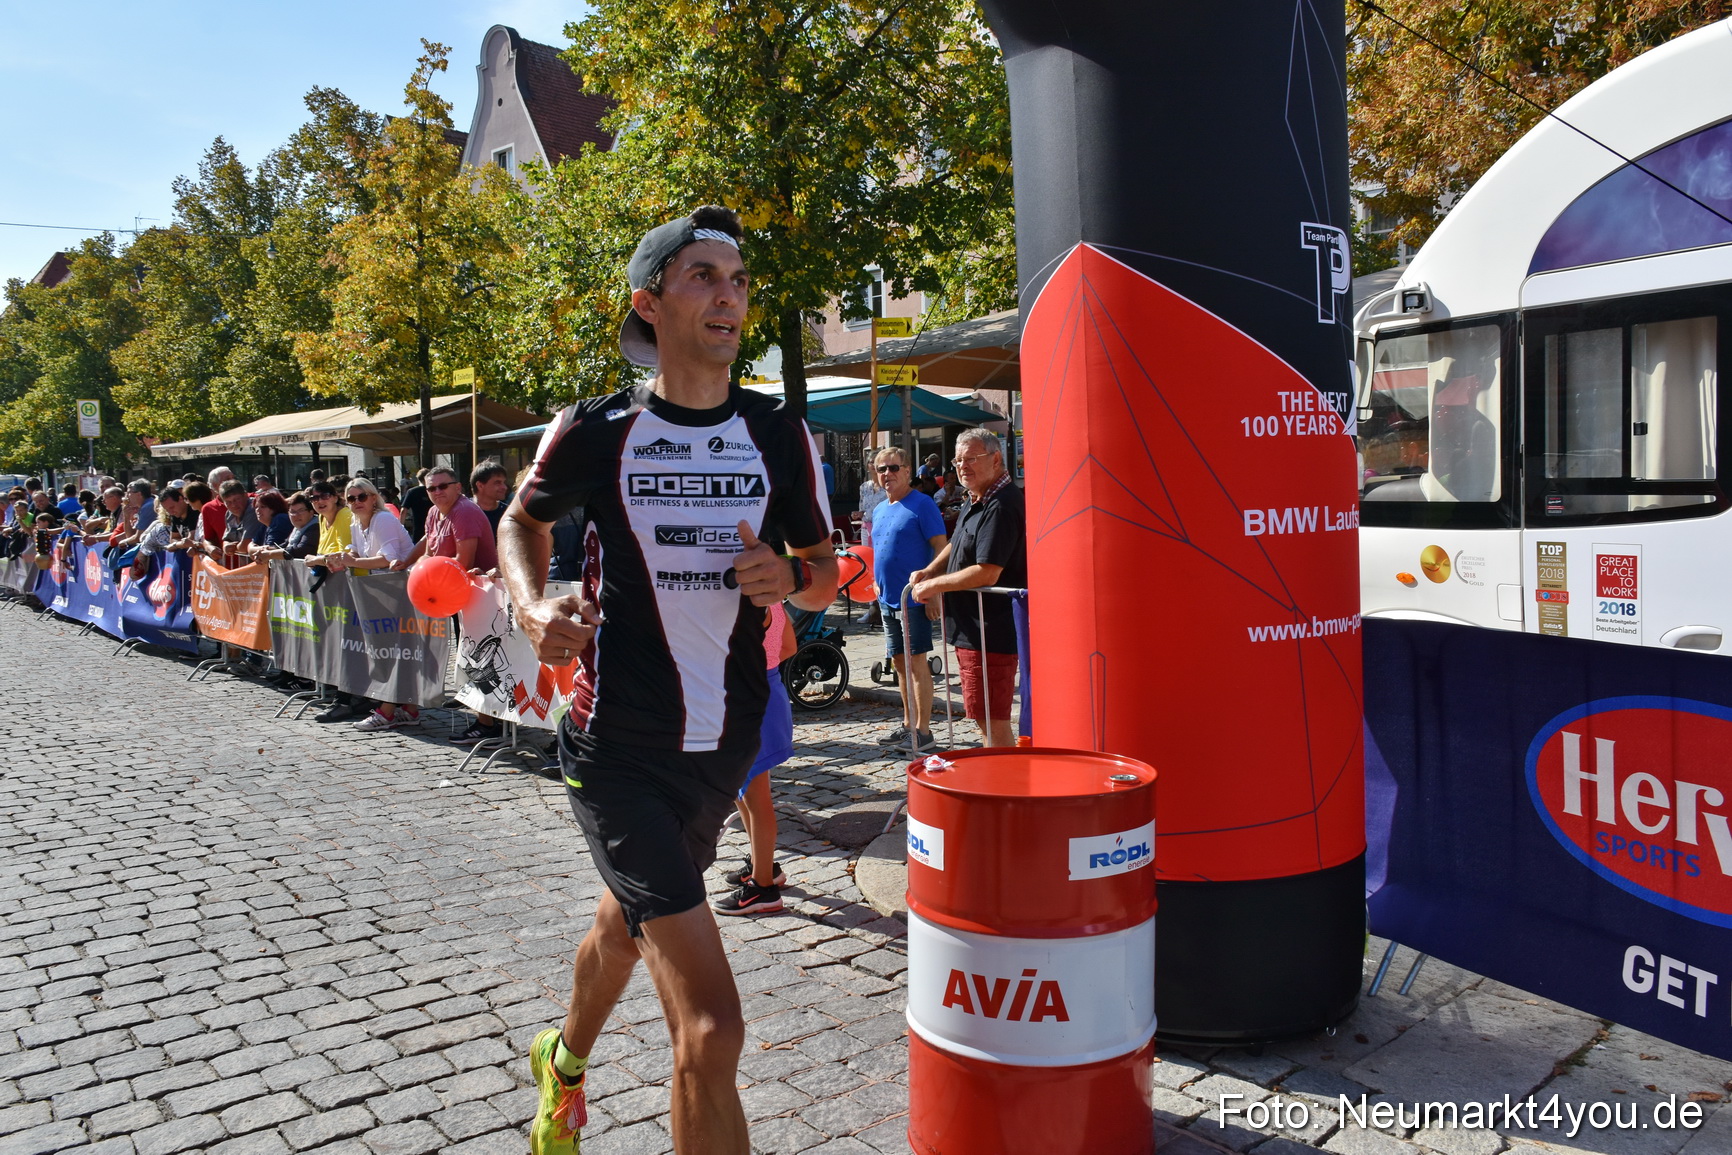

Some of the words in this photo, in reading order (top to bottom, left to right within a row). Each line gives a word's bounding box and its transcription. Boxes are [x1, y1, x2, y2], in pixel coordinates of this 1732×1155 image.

[1305, 231, 1326, 242] Team
[1278, 391, 1314, 412] THE
[1318, 391, 1348, 412] NEXT
[1240, 415, 1279, 437] 100
[1283, 415, 1337, 436] YEARS
[633, 445, 692, 456] WOLFRUM
[725, 441, 754, 452] ZURICH
[631, 475, 759, 495] POSITIV
[630, 498, 645, 506] DIE
[647, 499, 681, 507] FITNESS
[692, 499, 760, 508] WELLNESSGRUPPE
[1243, 506, 1319, 536] BMW
[1324, 504, 1359, 531] Laufs
[1539, 544, 1563, 555] TOP
[1599, 556, 1634, 566] GREAT
[656, 571, 722, 582] BRÖTJE
[1540, 568, 1564, 579] 2018
[1600, 566, 1634, 577] PLACE
[656, 582, 722, 591] HEIZUNG
[1619, 577, 1634, 587] TO
[1599, 601, 1636, 616] 2018
[1596, 625, 1637, 634] Deutschland
[1595, 831, 1701, 878] SPORTS
[1621, 944, 1718, 1018] GET
